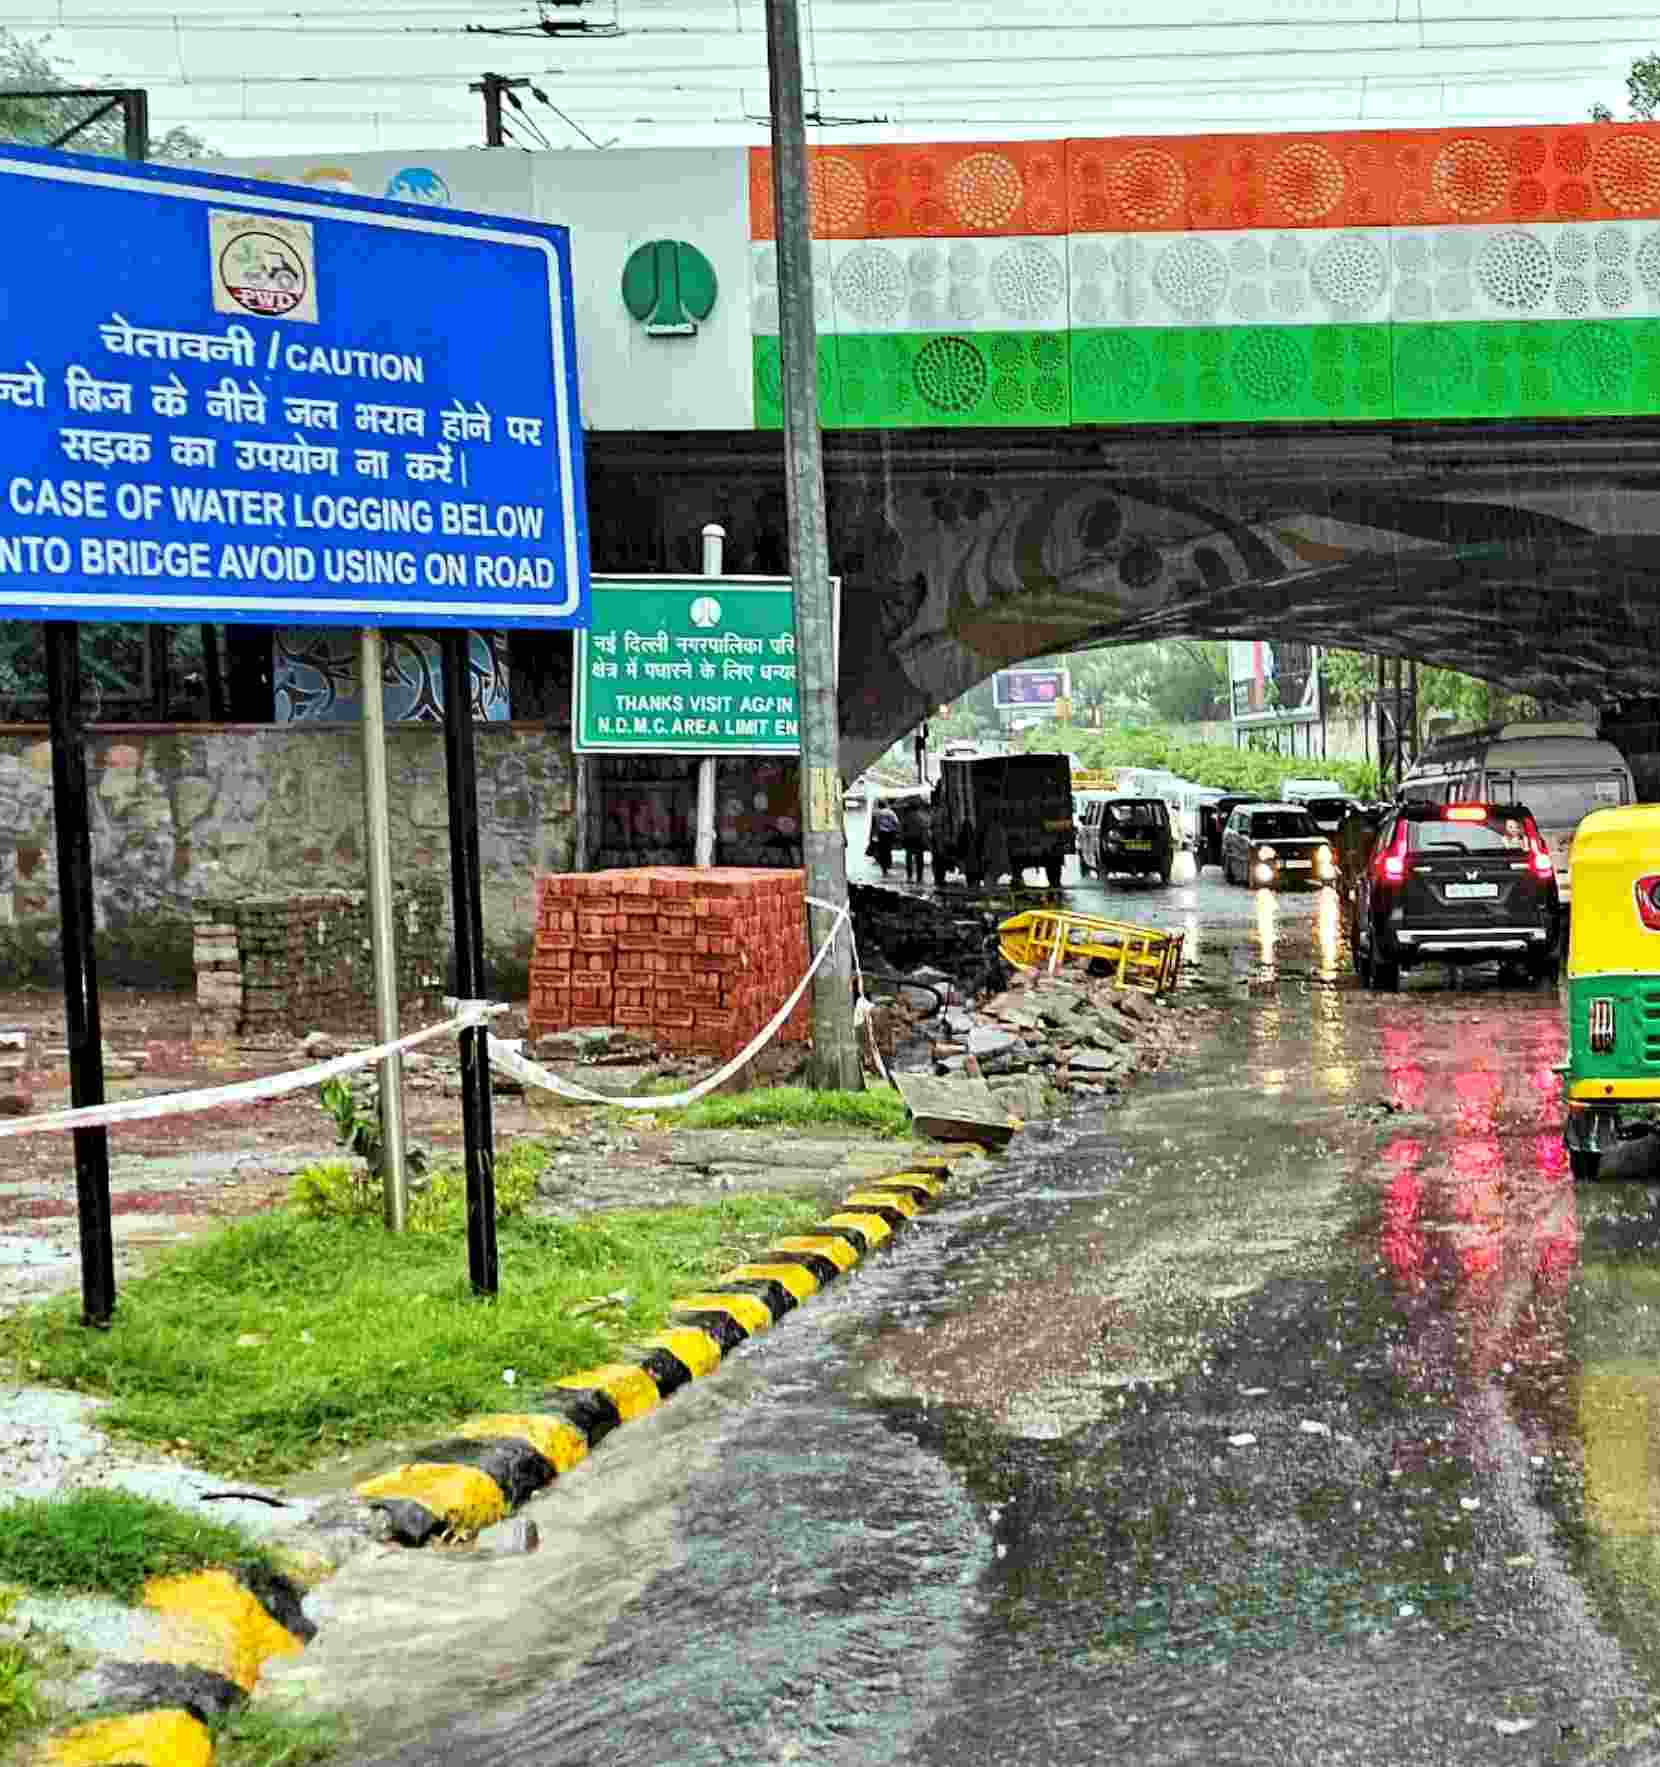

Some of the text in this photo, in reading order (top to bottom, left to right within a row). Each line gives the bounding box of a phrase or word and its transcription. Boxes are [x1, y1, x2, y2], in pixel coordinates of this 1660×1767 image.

[240, 287, 295, 309] PWD
[99, 312, 255, 367] चेतावनी
[0, 360, 46, 407] न्टो
[150, 372, 188, 416] के
[205, 377, 267, 424] नीचे
[283, 397, 338, 430] जल
[354, 403, 425, 437] भराव
[440, 399, 491, 442] होने
[505, 416, 542, 446] पर
[58, 428, 151, 469] सड़क
[169, 434, 216, 468] का
[233, 432, 338, 477] उपयोग
[354, 449, 388, 479] ना
[9, 477, 544, 539] CASE OF WATER LOGGING BELOW
[0, 535, 554, 589] NTO BRIDGE AVOID USING ON ROAD
[592, 630, 795, 654] नई दिल्ली नगरपालिका परि
[592, 656, 618, 680] क्षेत्र
[625, 656, 637, 680] में
[699, 657, 715, 680] के
[722, 657, 755, 684] लिए
[616, 695, 793, 713] THANKS VISIT AGAIN
[672, 718, 720, 735] AREA
[724, 719, 768, 736] LIMIT
[775, 719, 799, 736] EN
